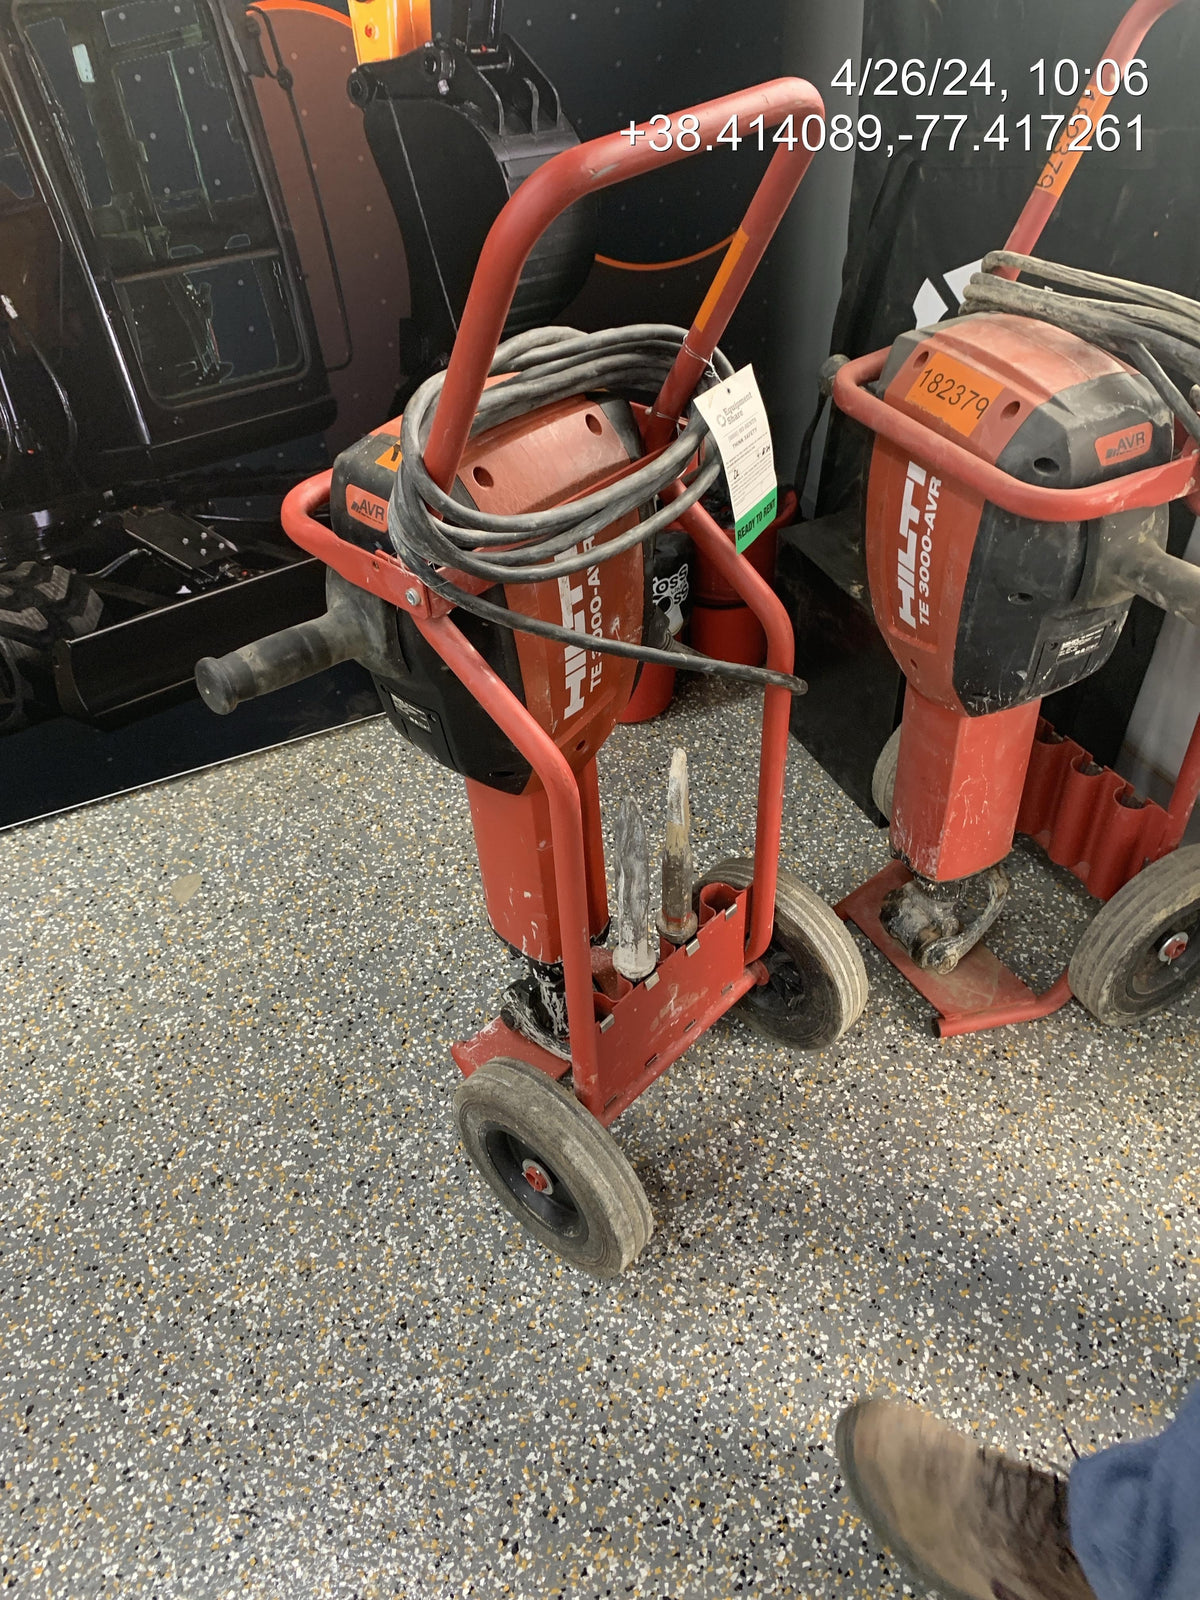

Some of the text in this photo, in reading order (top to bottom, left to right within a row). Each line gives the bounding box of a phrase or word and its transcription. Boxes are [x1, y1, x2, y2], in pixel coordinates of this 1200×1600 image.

[722, 391, 752, 416] Equipment
[918, 368, 990, 420] 182379
[726, 409, 744, 425] Share
[1117, 431, 1145, 451] AVR
[360, 499, 385, 521] AVR
[737, 498, 776, 541] READY TO RENT
[897, 460, 927, 630] HILTI
[918, 476, 942, 626] TE 3000-AVR
[589, 661, 603, 693] TE
